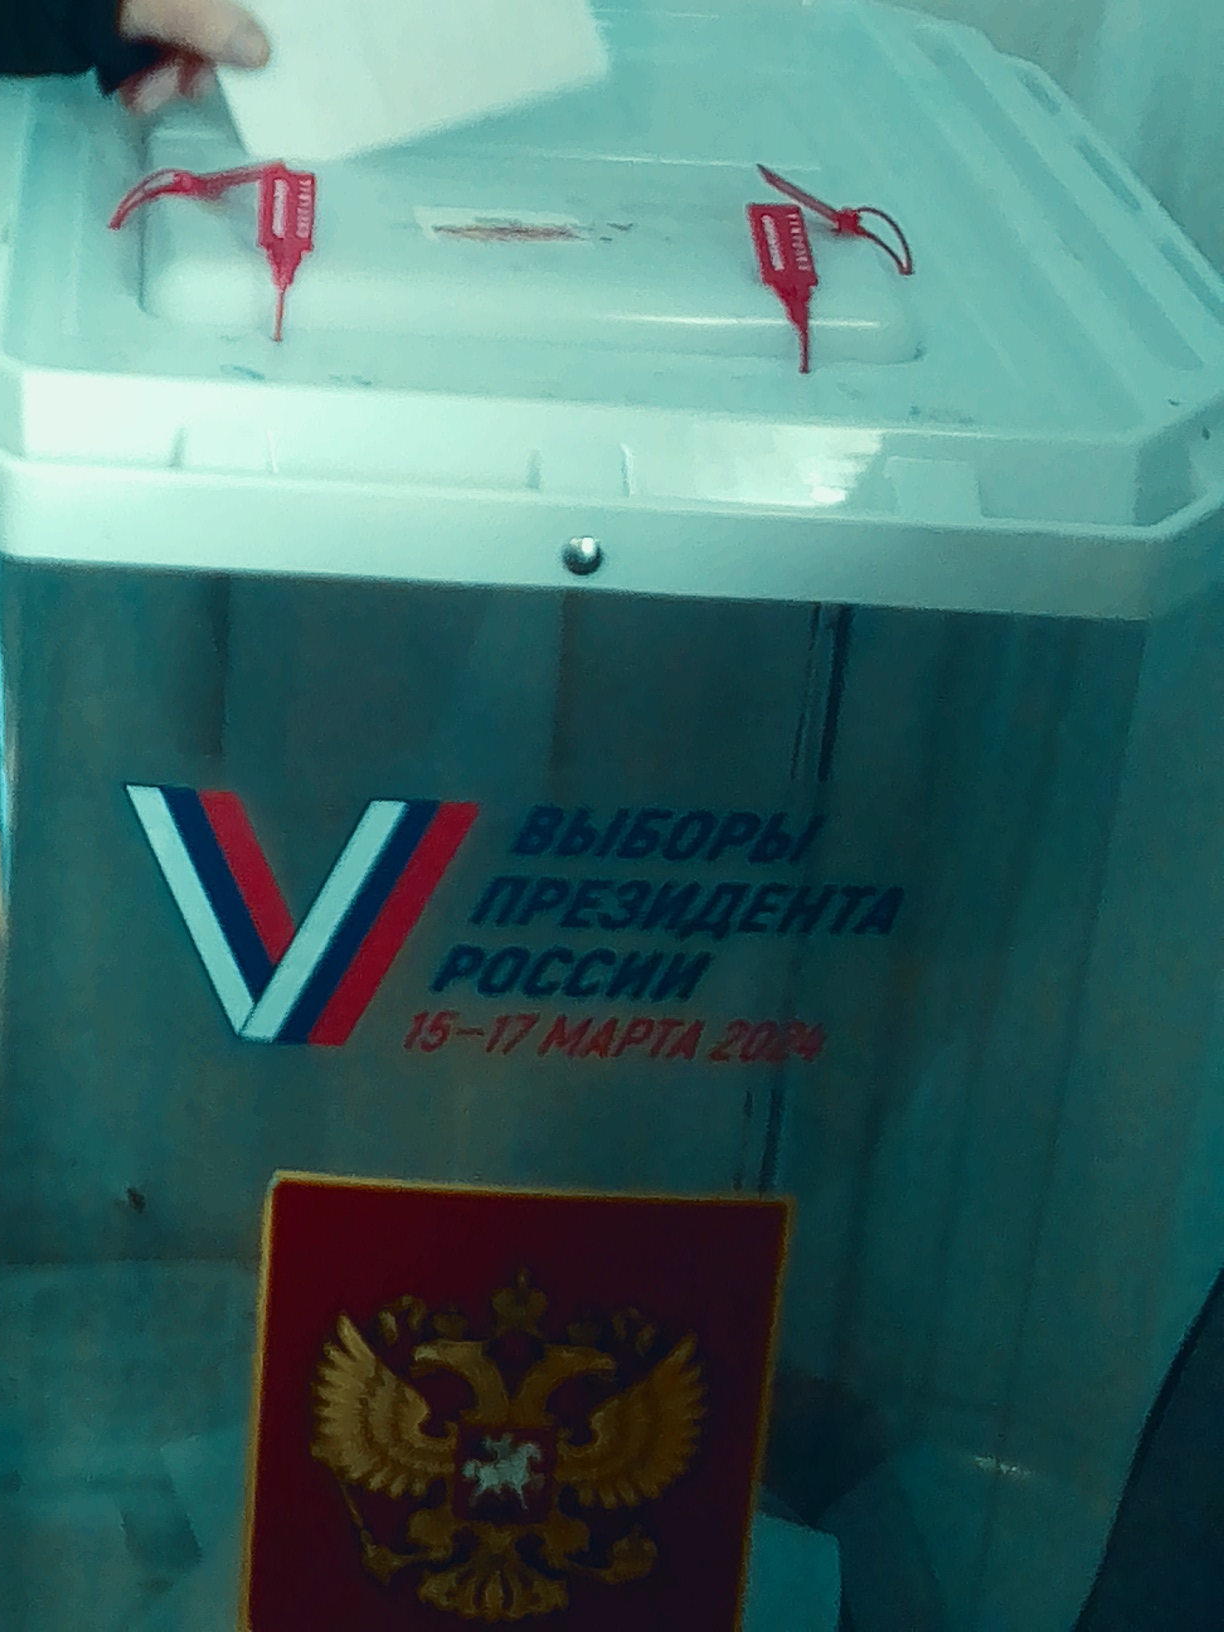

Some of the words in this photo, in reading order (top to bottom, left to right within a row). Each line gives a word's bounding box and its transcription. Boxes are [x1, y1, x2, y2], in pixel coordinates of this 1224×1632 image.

[512, 804, 826, 865] ВЫБОРЫ
[468, 876, 904, 941] ПРЕЗИДЕНТА
[428, 944, 714, 1002] РОССИИ
[537, 1014, 702, 1062] МАРТА
[707, 1018, 826, 1066] 2024
